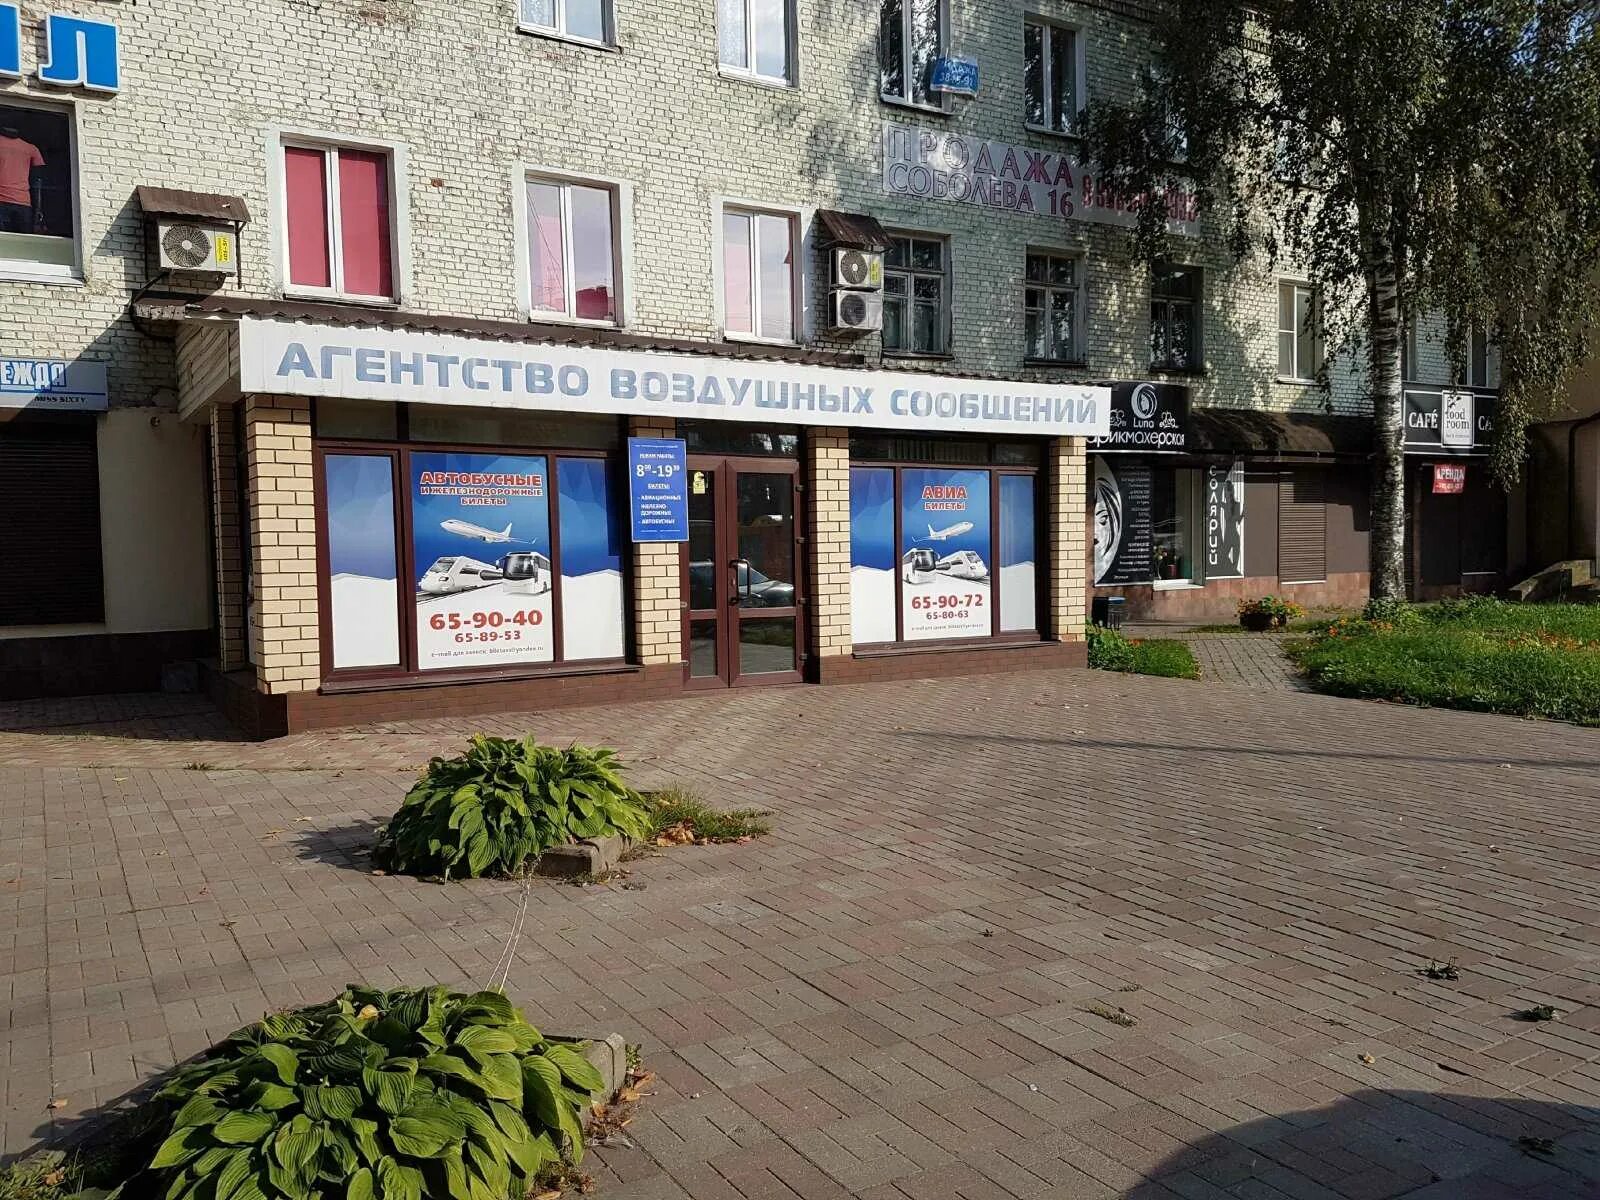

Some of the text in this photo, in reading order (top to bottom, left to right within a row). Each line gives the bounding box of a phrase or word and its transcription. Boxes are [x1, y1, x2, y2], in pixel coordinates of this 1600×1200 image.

[888, 126, 1074, 188] ПРОДАЖА
[888, 163, 1035, 212] СОБОЛЕВА
[1047, 188, 1074, 217] 16
[276, 342, 1098, 424] АГЕНТСТВО ВОЗДУШНЫХ СООБЩЕНИЙ
[1408, 409, 1438, 429] CAFÉ
[1445, 407, 1466, 420] food
[1133, 418, 1154, 428] Luna
[1446, 420, 1470, 430] room
[420, 471, 543, 487] АВТОБУСНЫЕ
[922, 486, 967, 499] АВИА
[461, 497, 507, 506] БИЛЕТЫ
[924, 502, 966, 510] БИЛЕТЫ
[911, 594, 983, 609] 65-90-72
[429, 609, 544, 631] 65-90-40
[926, 610, 969, 620] 65-80-63
[454, 630, 521, 643] 65-89-53
